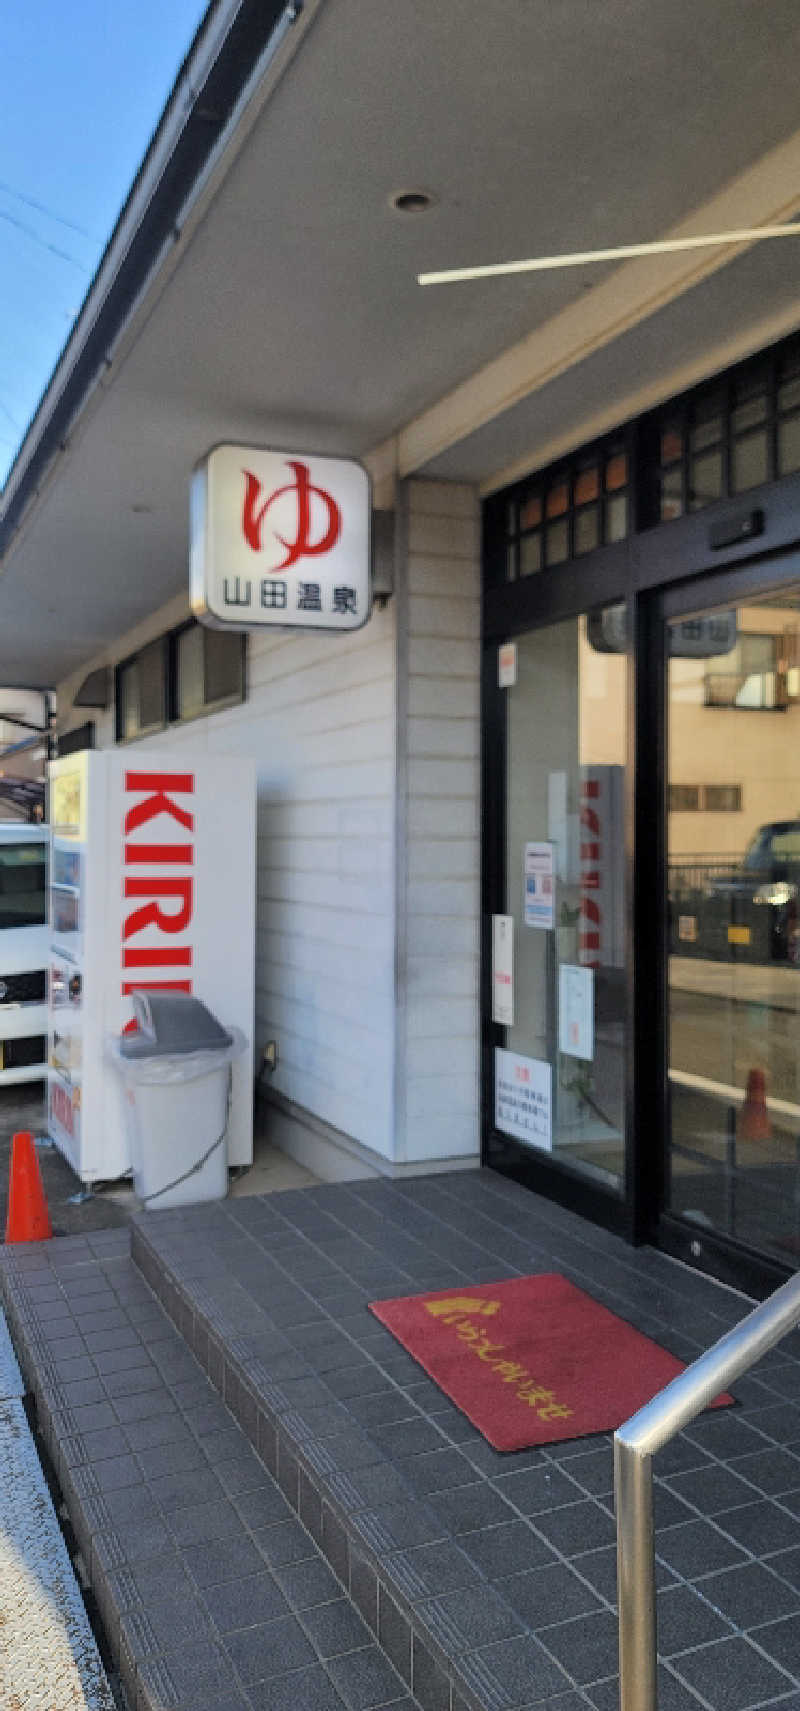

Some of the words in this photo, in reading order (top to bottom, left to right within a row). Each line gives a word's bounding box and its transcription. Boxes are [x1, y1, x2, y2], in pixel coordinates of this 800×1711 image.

[241, 461, 342, 573] ゆ
[223, 575, 357, 614] 山田温泉
